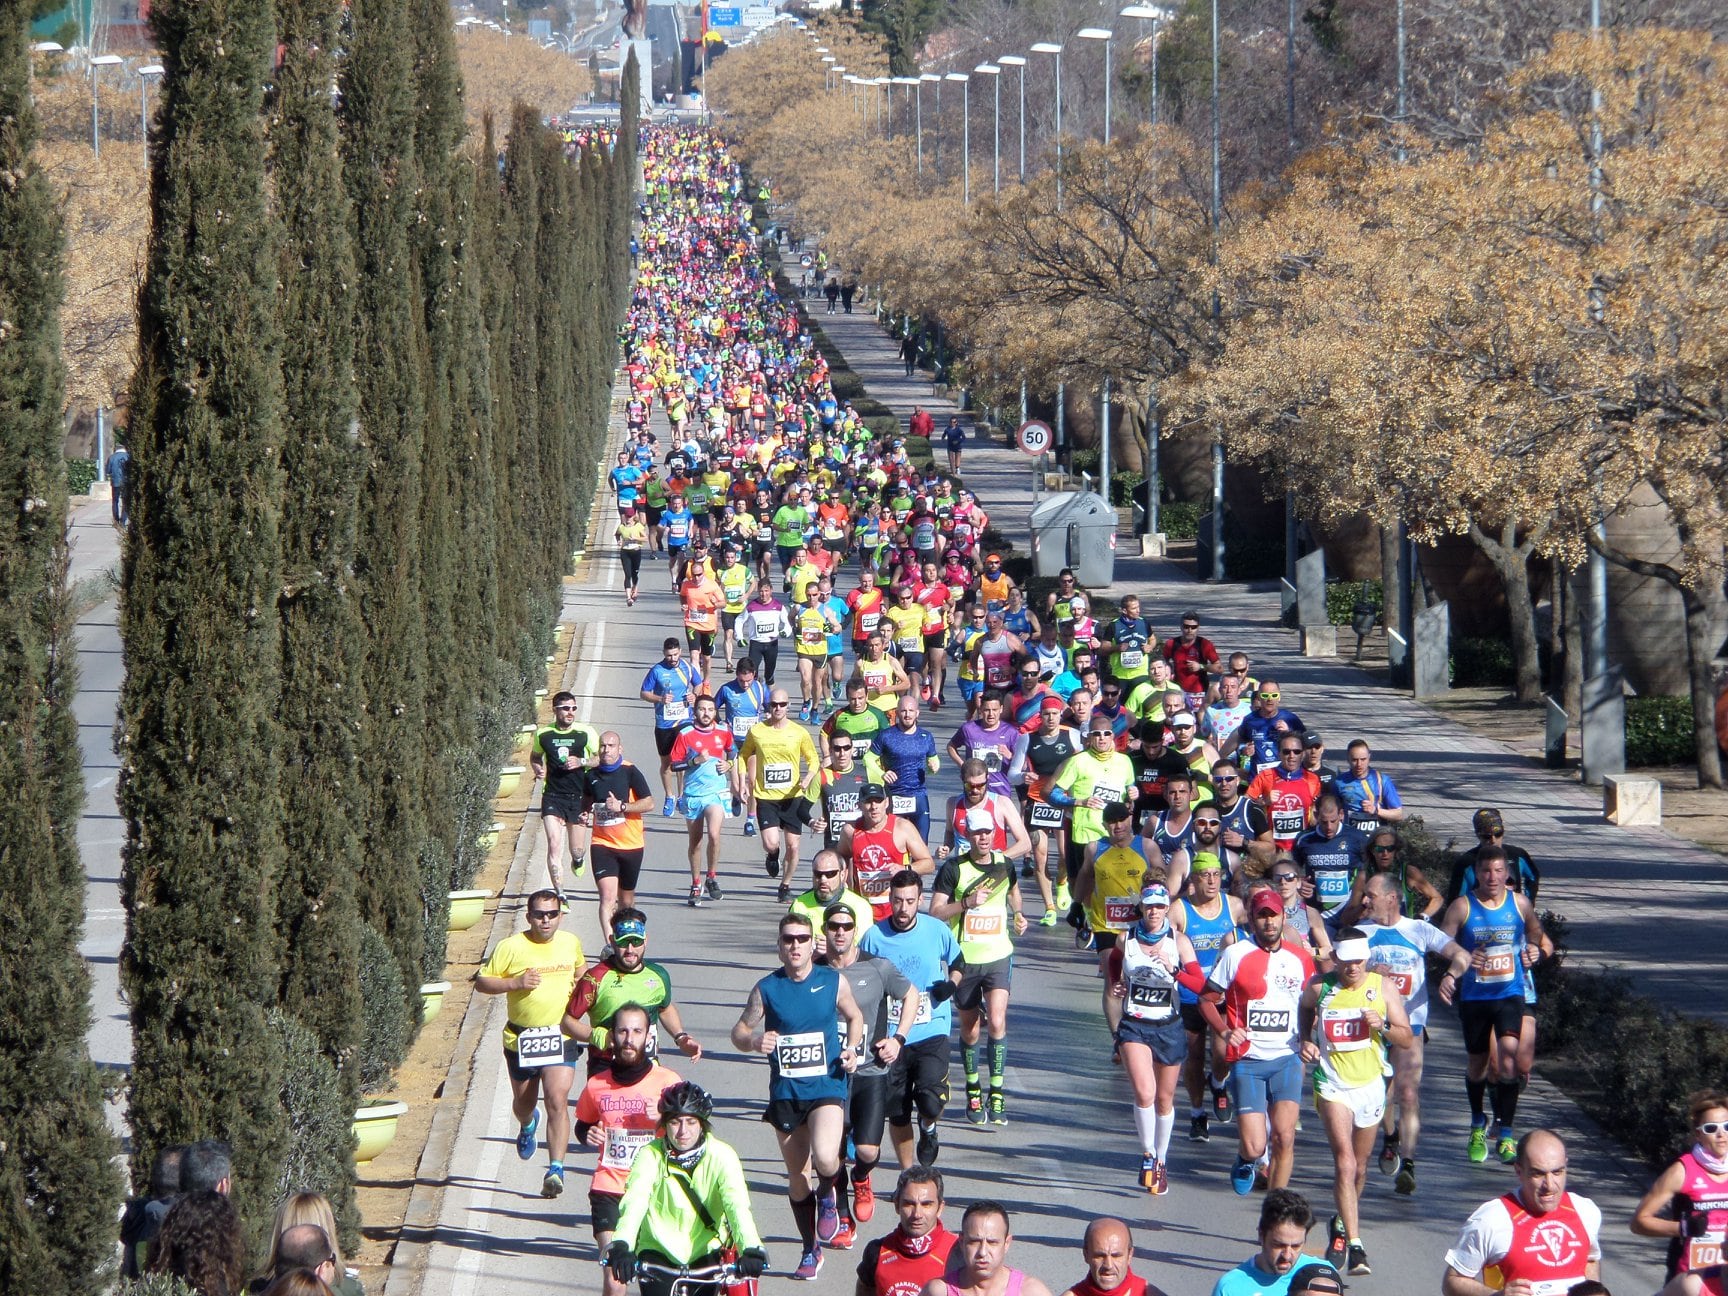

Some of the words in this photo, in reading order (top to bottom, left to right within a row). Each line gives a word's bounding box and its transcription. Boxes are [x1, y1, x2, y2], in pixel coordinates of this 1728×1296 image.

[1026, 432, 1043, 444] 50
[768, 771, 790, 780] 2129
[1094, 788, 1120, 802] 2299
[1035, 807, 1061, 818] 2078
[1276, 819, 1301, 830] 2156
[1320, 881, 1343, 891] 469
[969, 917, 999, 930] 1087
[1135, 988, 1167, 1001] 2127
[1250, 1012, 1288, 1027] 2034
[1333, 1022, 1360, 1037] 601
[521, 1037, 560, 1054] 2336
[781, 1045, 822, 1063] 2396
